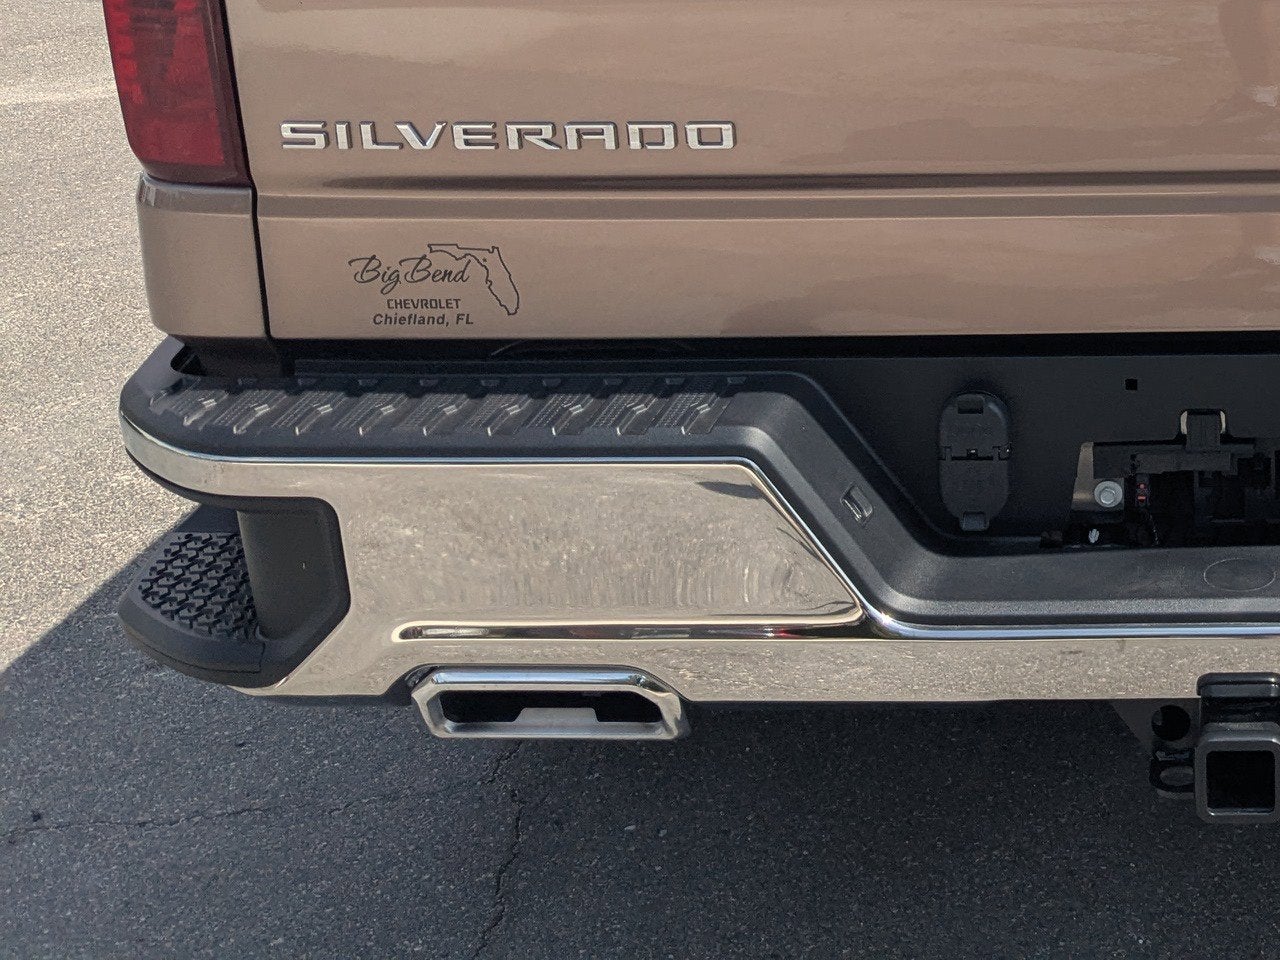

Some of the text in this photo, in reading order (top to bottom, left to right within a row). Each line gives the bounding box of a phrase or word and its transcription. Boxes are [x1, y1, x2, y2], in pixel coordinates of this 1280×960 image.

[280, 120, 738, 151] SILVERADO
[348, 254, 471, 295] Big Bend
[386, 298, 461, 309] CHEVROLET
[372, 313, 474, 327] Chiefland, FL
